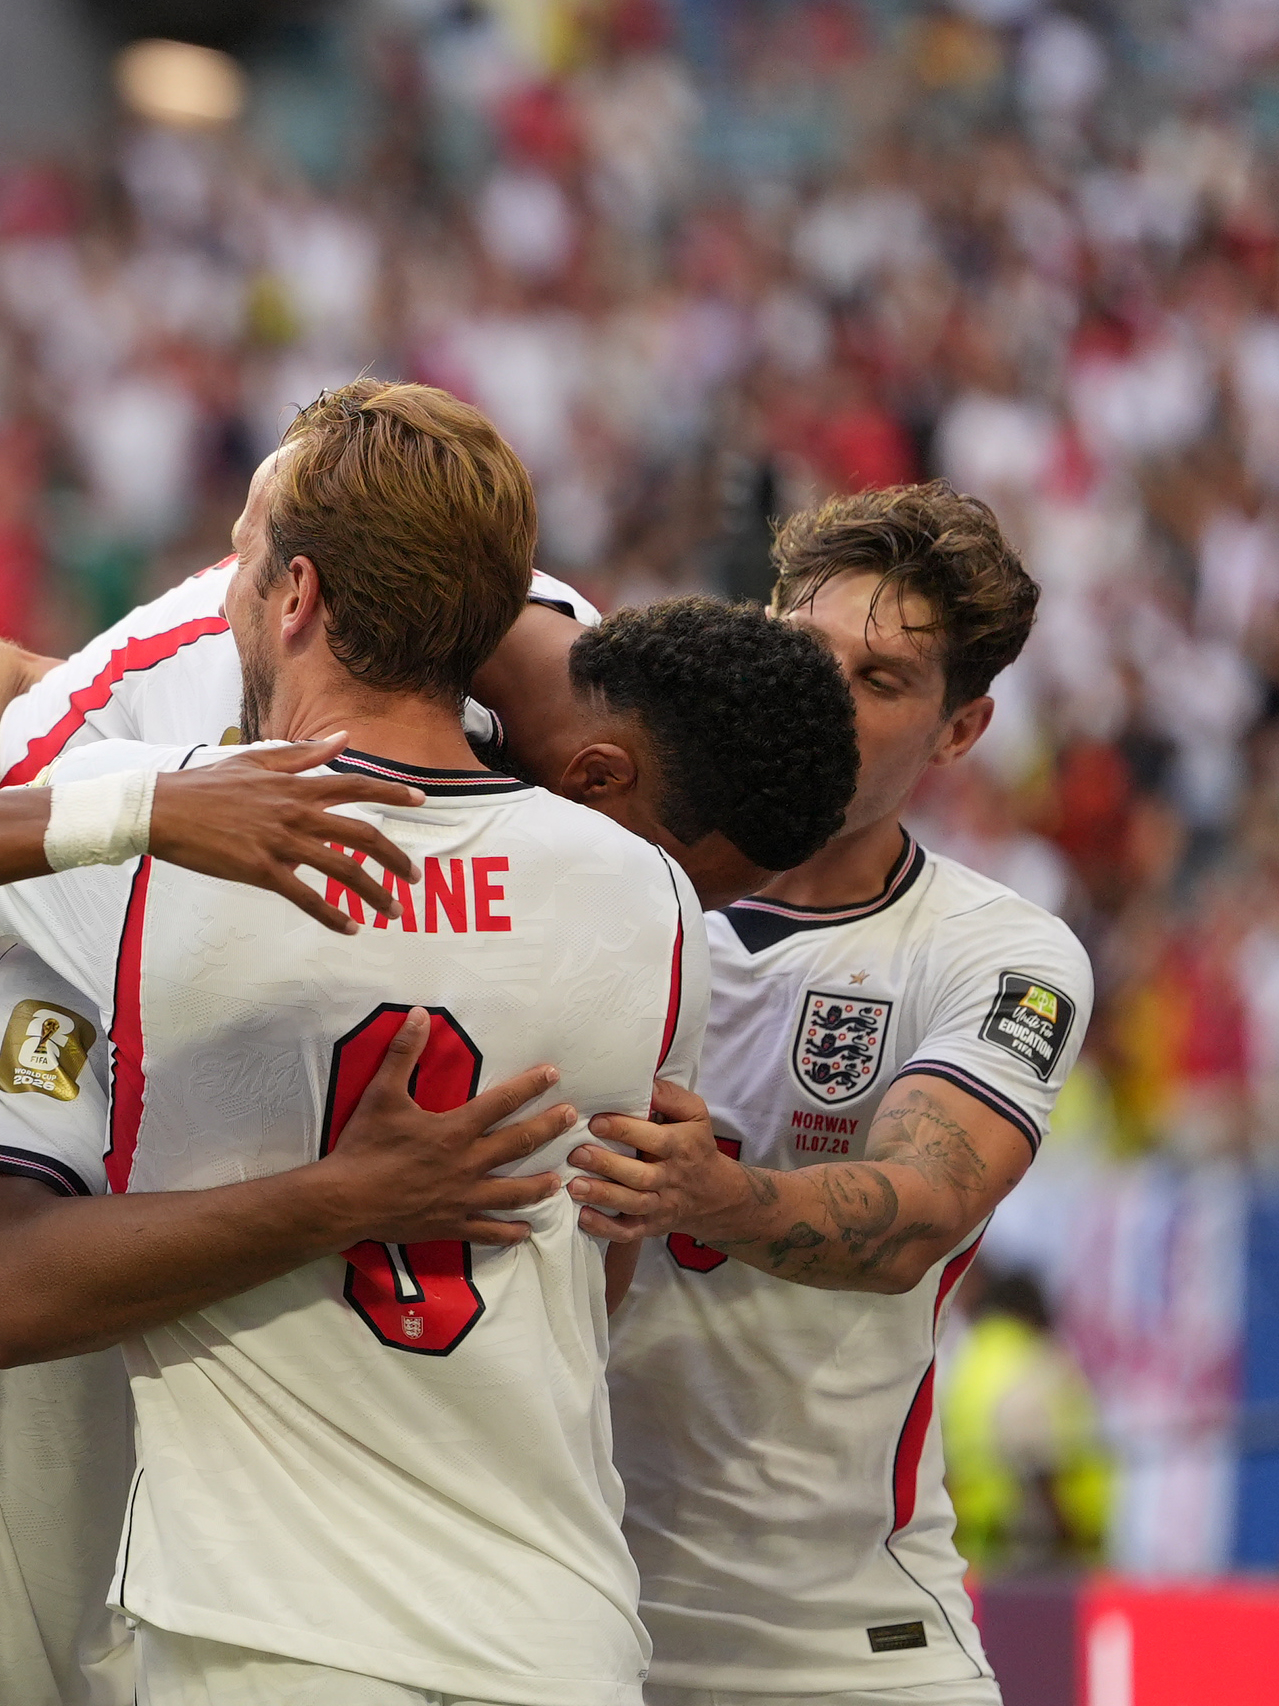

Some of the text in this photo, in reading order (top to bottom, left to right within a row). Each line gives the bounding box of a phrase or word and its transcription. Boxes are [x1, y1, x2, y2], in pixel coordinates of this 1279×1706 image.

[324, 842, 512, 933] KANE
[1012, 1006, 1054, 1038] Unite For
[998, 1017, 1054, 1061] EDUCATION
[1012, 1039, 1033, 1057] FIFA
[30, 1055, 48, 1065] FIFA
[13, 1075, 56, 1091] 2026
[14, 1067, 57, 1081] WORLD CUP
[791, 1110, 859, 1135] NORWAY
[795, 1133, 850, 1155] 11.07.26
